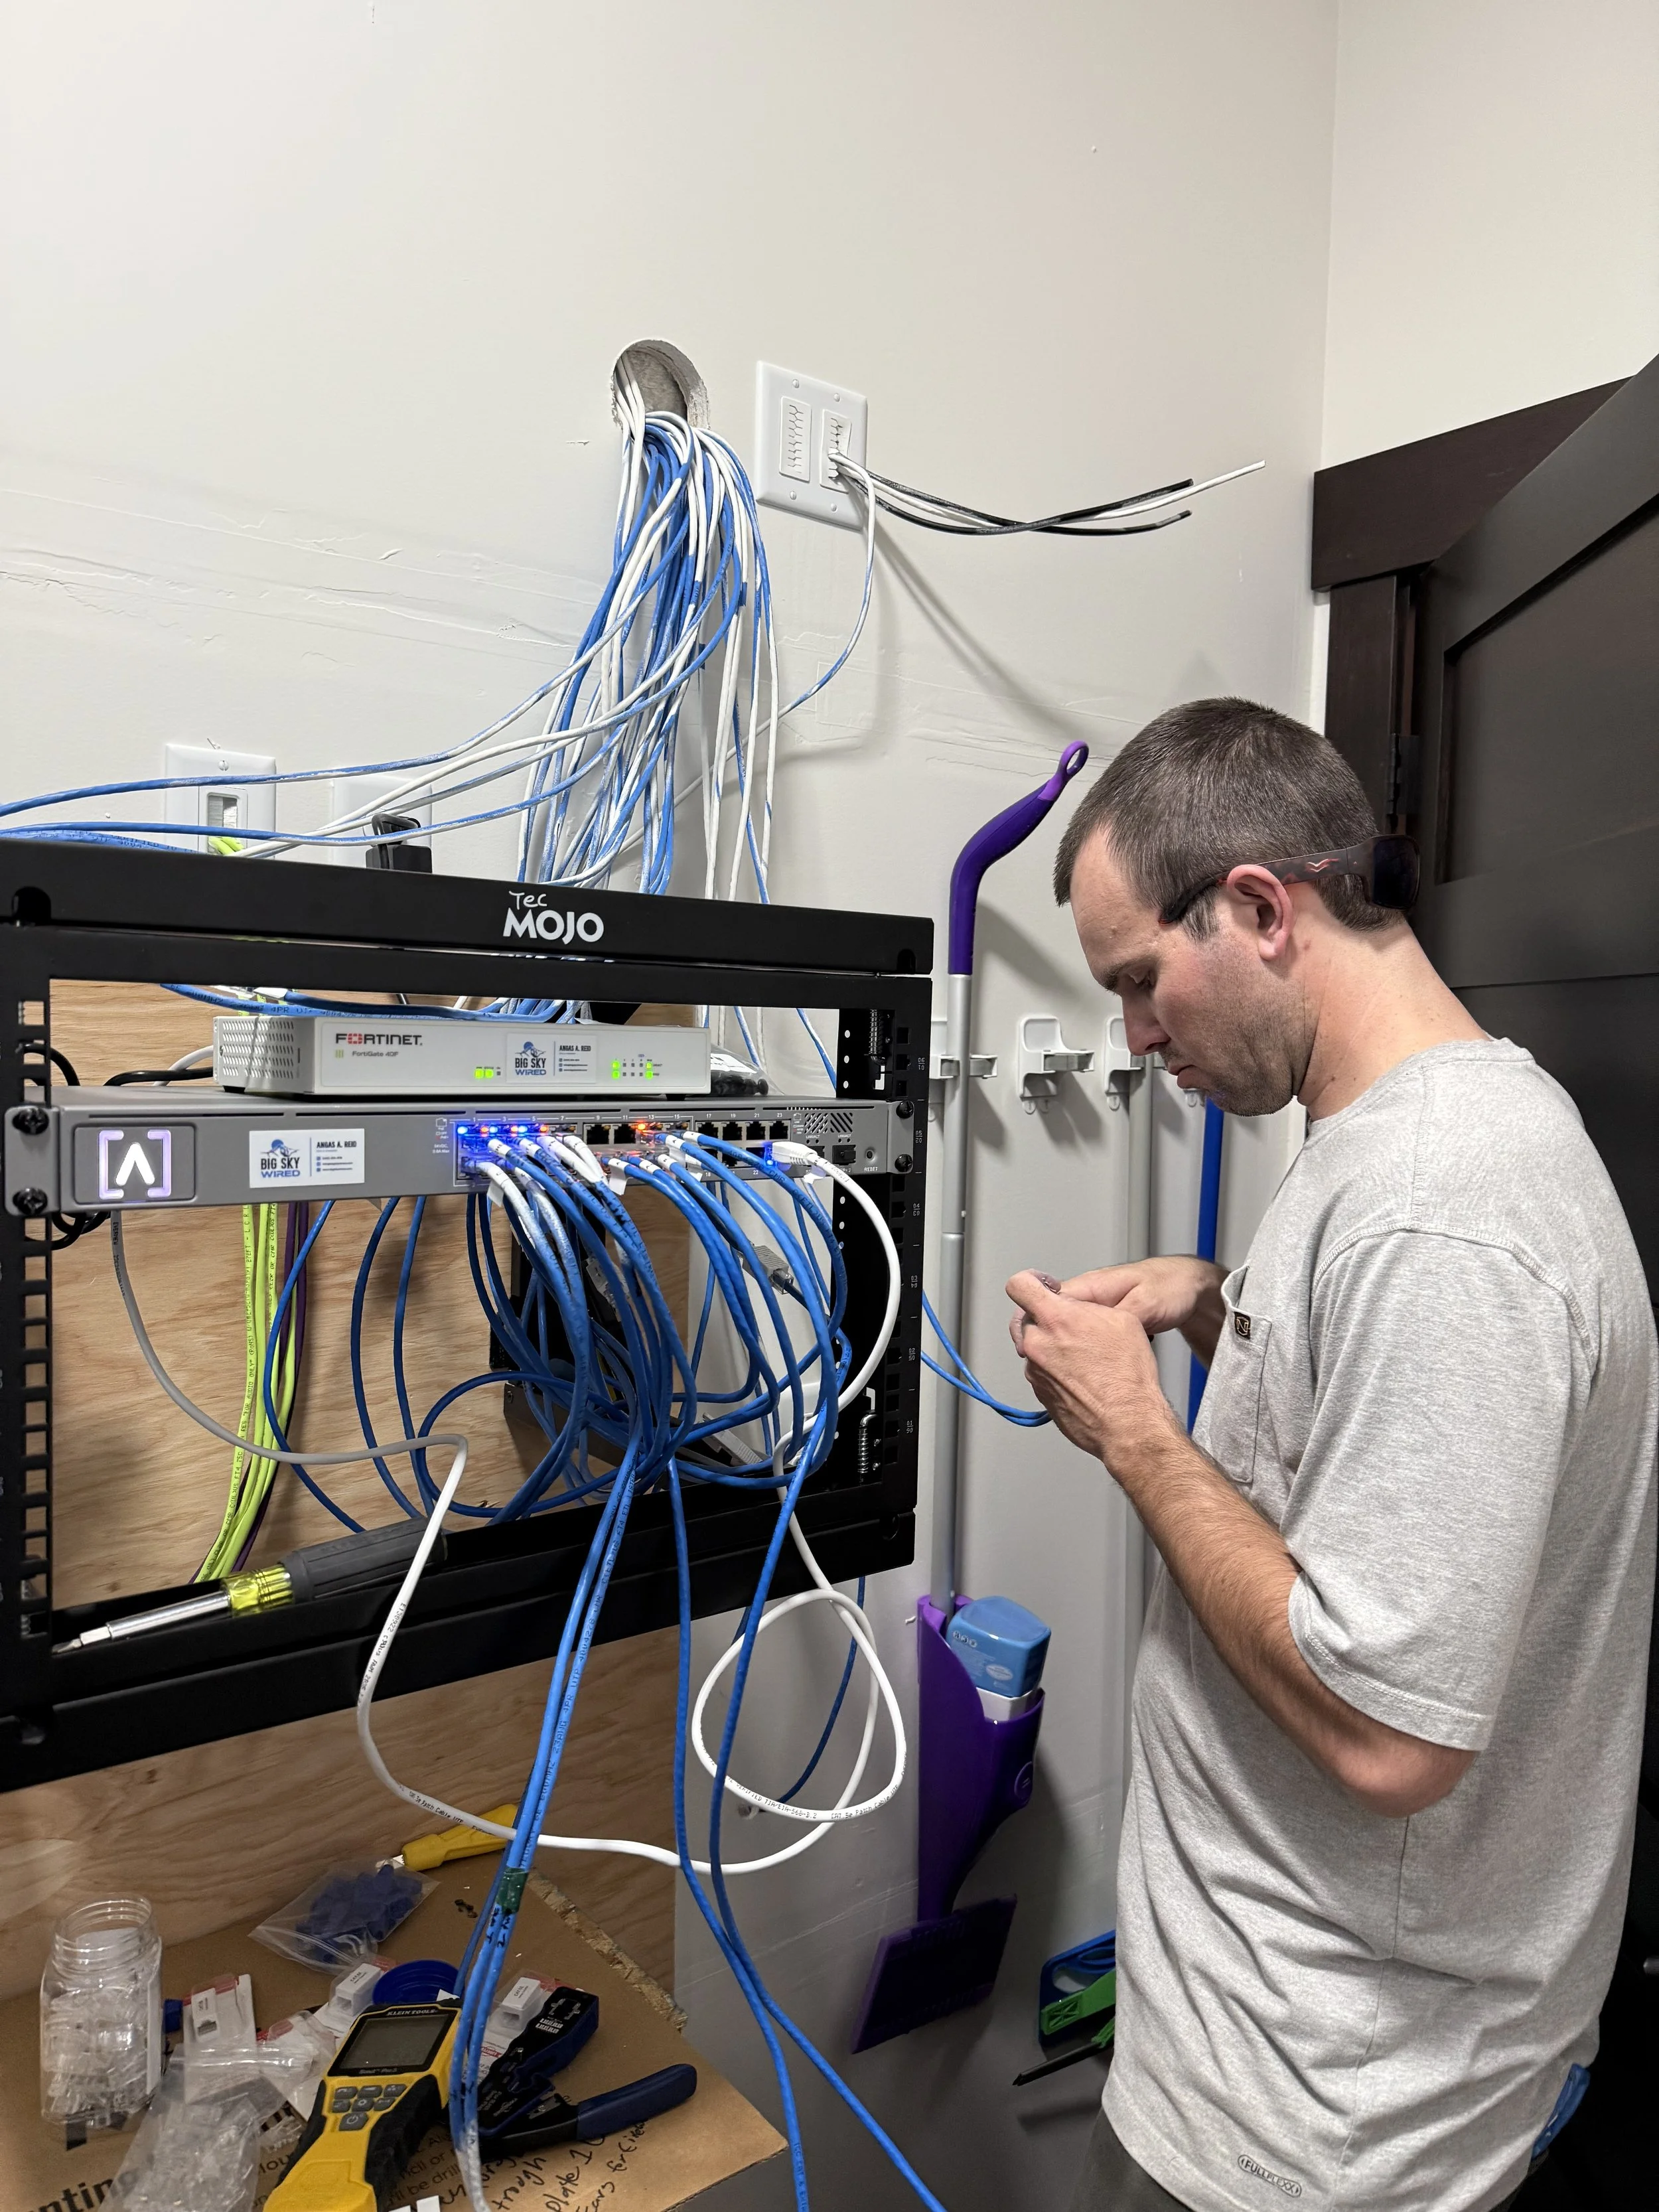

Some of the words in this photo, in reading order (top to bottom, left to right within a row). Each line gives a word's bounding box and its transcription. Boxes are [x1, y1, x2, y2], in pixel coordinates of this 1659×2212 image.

[508, 891, 547, 910] Tec
[503, 907, 604, 944] MOJO
[515, 1058, 528, 1068] BIG
[531, 1058, 547, 1069] SKY
[261, 1158, 277, 1170] BIG
[281, 1157, 300, 1169] SKY
[569, 1667, 581, 1688] UTP
[428, 2151, 447, 2166] or
[1244, 2160, 1295, 2193] FULLFLEXX
[407, 2177, 430, 2195] be
